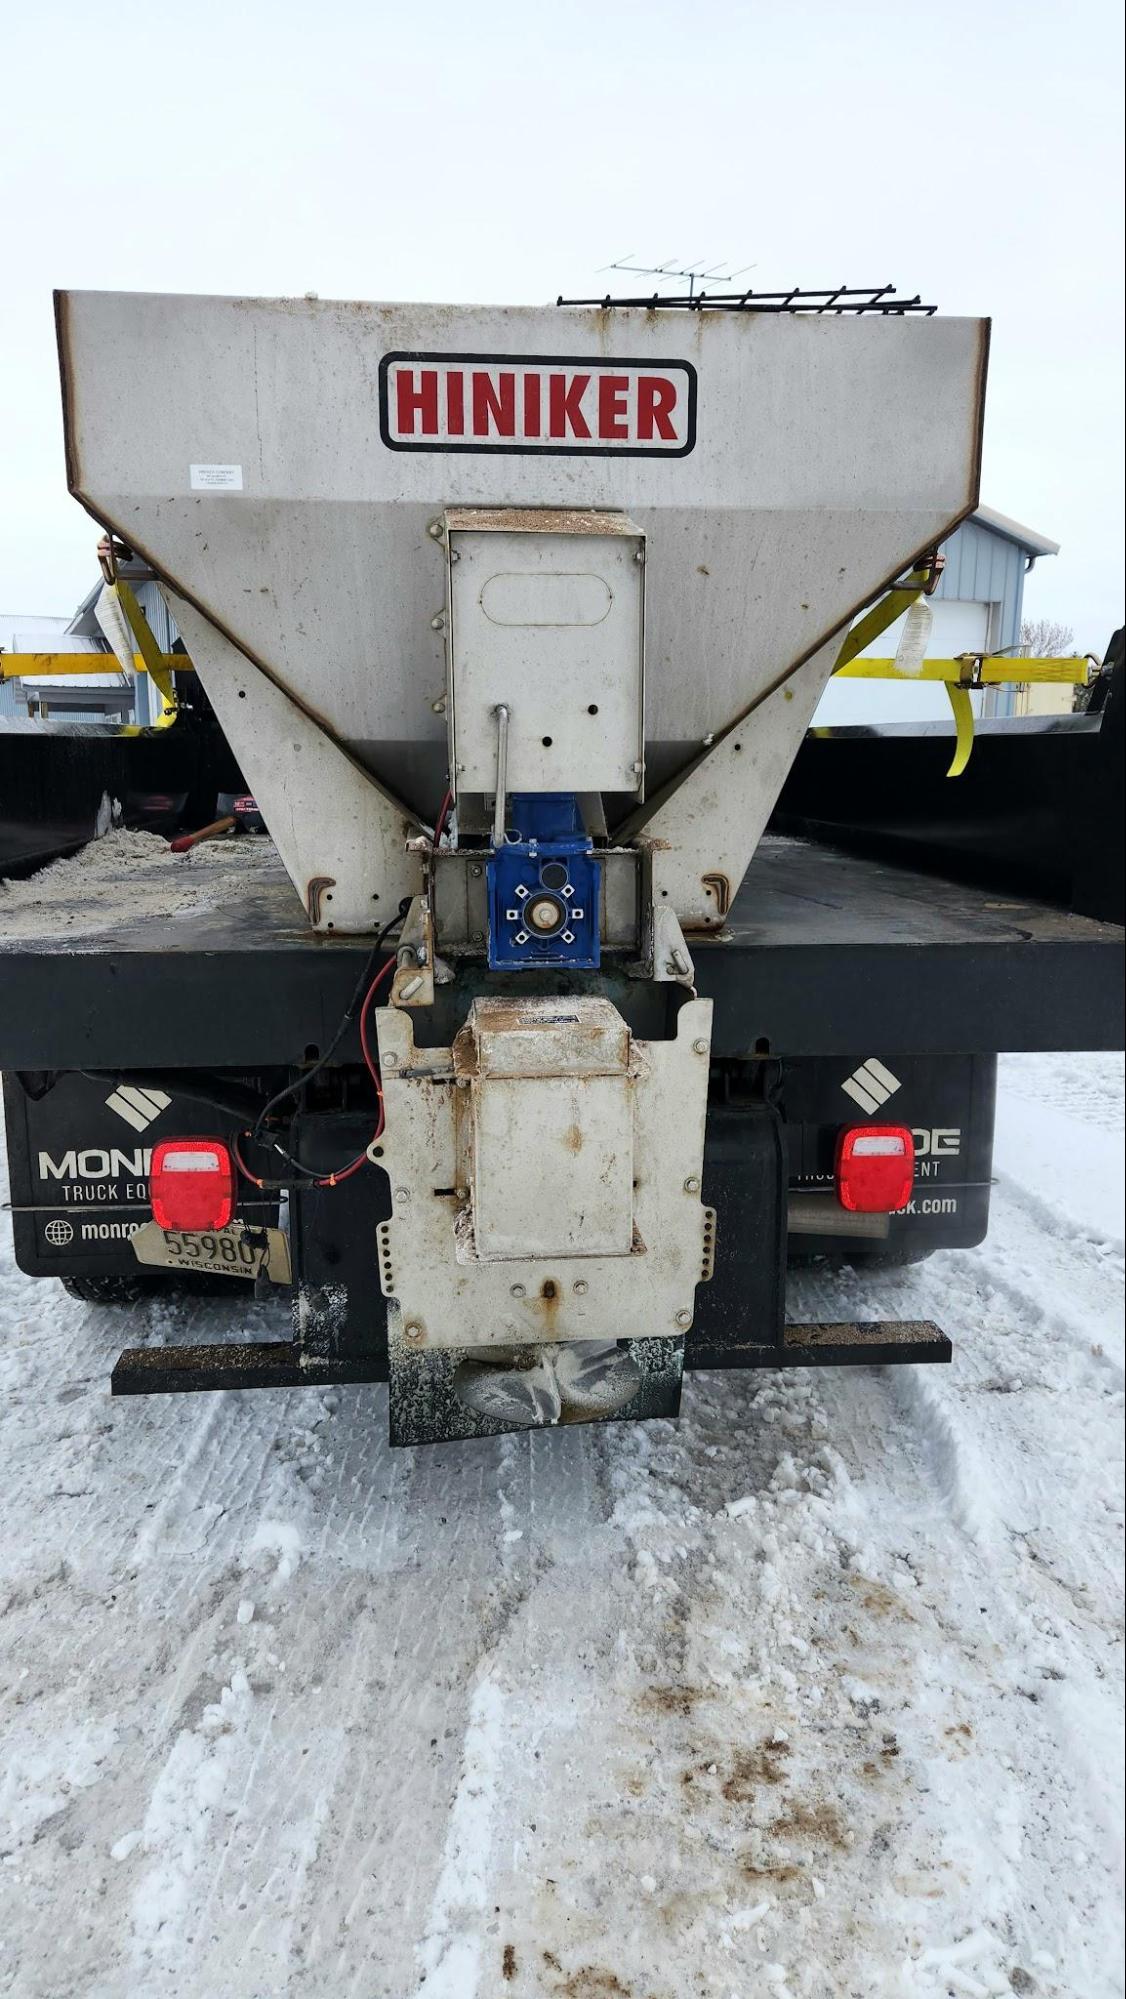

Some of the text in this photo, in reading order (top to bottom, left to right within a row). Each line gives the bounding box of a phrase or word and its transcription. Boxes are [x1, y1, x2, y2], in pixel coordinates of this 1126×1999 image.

[395, 369, 679, 440] HINIKER
[910, 1128, 961, 1157] OE
[38, 1148, 152, 1180] MON
[913, 1160, 941, 1177] ENT
[61, 1183, 150, 1201] TRUCK EQ
[81, 1222, 147, 1240] monro
[163, 1230, 256, 1265] 55980
[178, 1258, 252, 1274] WISCONSIN
